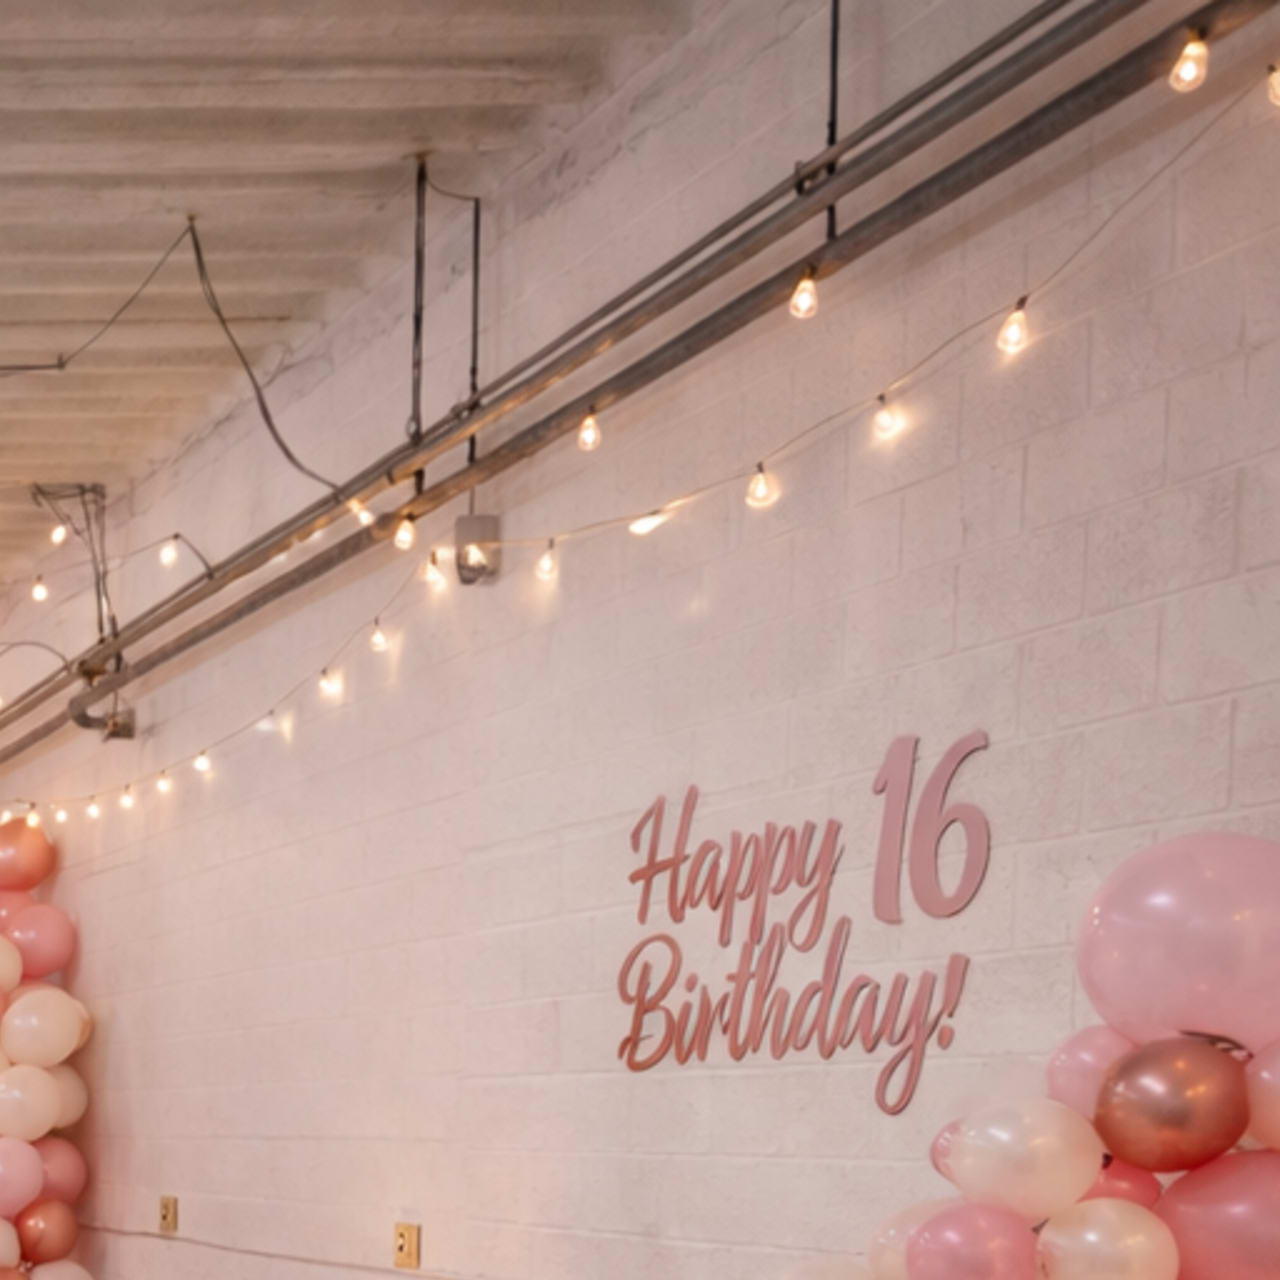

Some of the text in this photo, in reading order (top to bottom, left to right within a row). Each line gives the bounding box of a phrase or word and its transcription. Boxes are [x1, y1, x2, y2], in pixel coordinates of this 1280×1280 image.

[628, 730, 991, 953] Happy 16
[618, 915, 971, 1116] Birthday!
